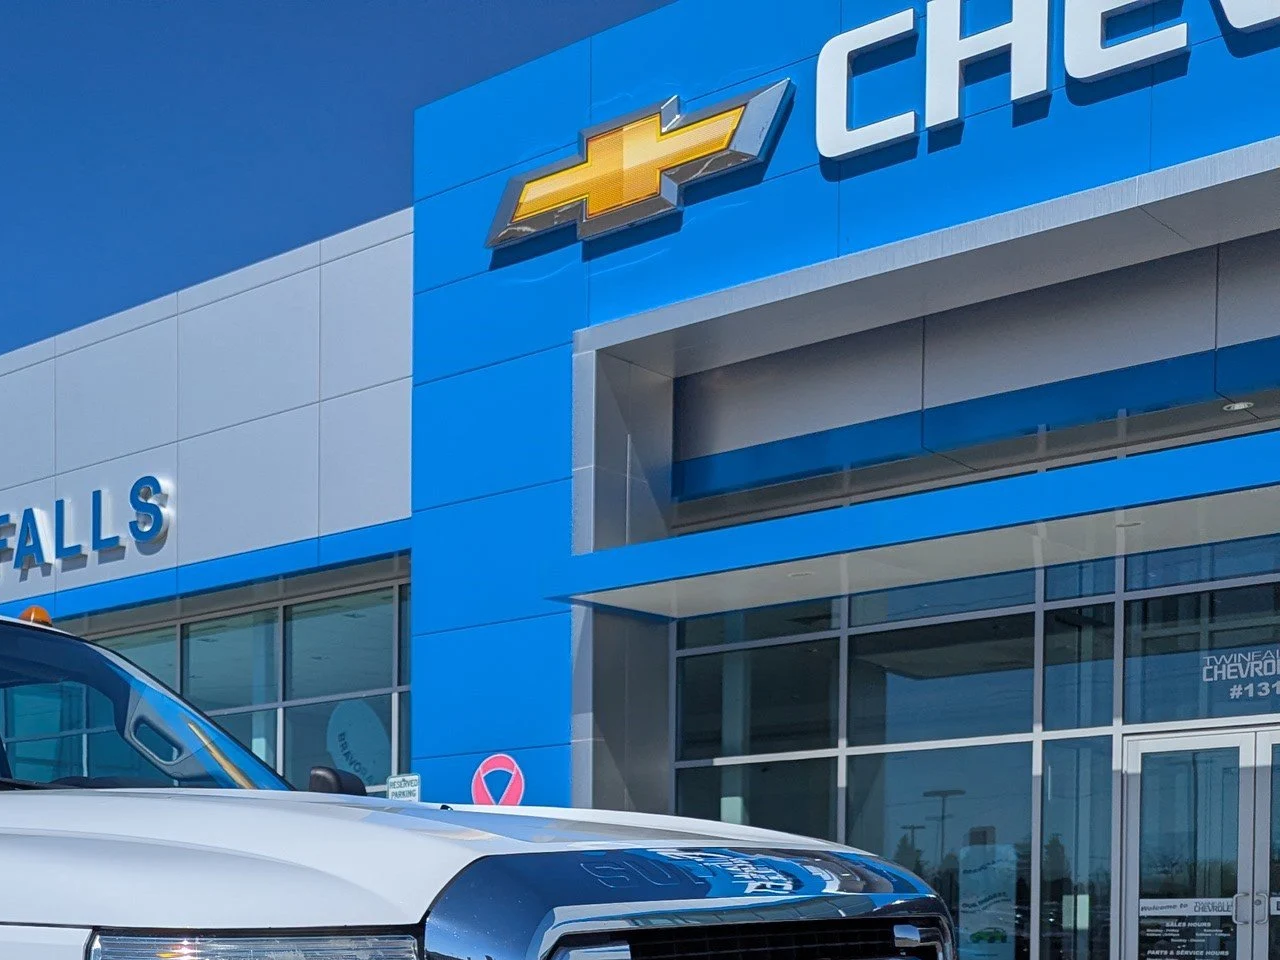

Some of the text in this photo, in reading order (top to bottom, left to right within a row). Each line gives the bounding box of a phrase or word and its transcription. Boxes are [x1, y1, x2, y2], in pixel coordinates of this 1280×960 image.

[816, 0, 1280, 158] CHE
[1203, 650, 1280, 666] TWINFA
[1202, 660, 1280, 682] CHEVRO
[389, 779, 418, 789] RESERVED
[391, 789, 417, 799] PARKING
[1140, 903, 1178, 912] Welcome
